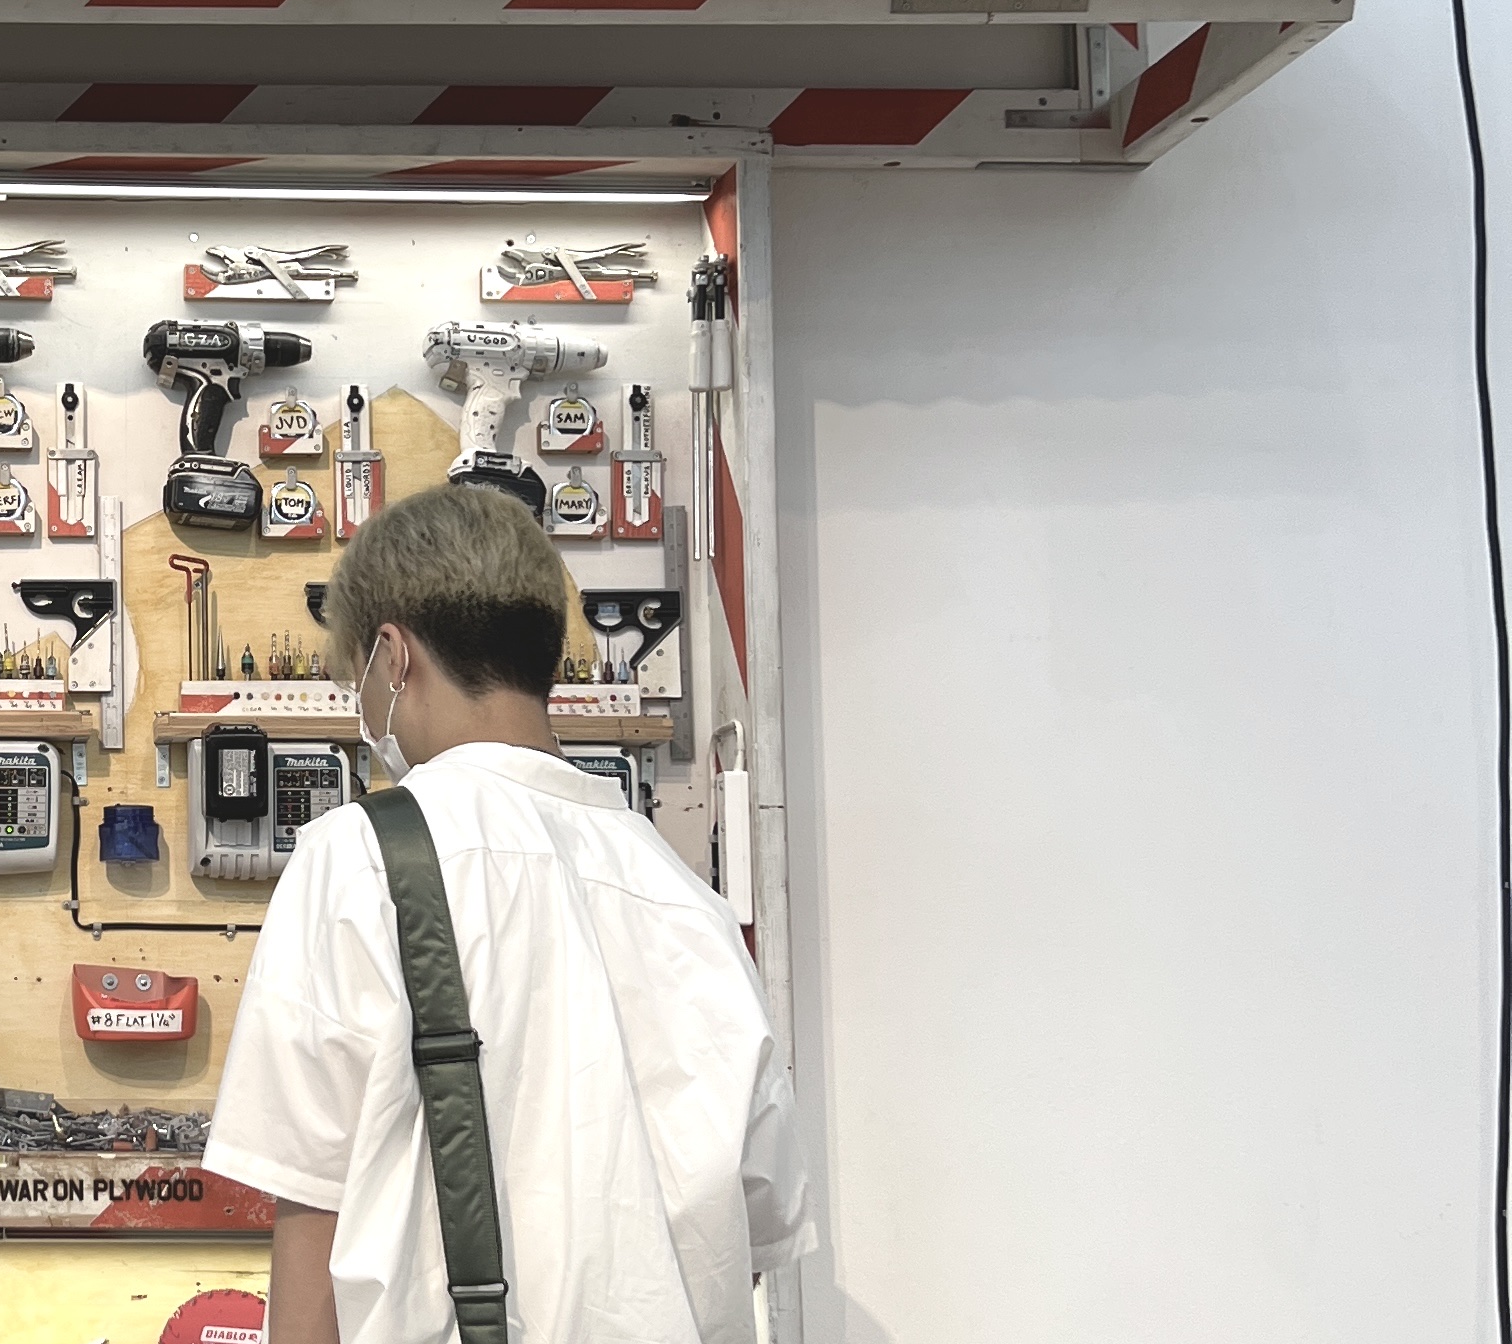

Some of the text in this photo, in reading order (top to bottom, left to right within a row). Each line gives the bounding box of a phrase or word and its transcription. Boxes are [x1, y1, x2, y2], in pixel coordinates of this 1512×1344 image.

[184, 333, 222, 347] GZA
[467, 333, 508, 346] U-GOD
[275, 415, 308, 431] JVD
[556, 413, 586, 424] SAM
[282, 497, 305, 508] TOM
[558, 497, 591, 509] MARY
[284, 757, 329, 767] makita
[573, 758, 617, 770] makita
[91, 1012, 114, 1028] #8
[115, 1014, 147, 1028] FLAT
[0, 1178, 49, 1202] WAR
[52, 1178, 84, 1202] ON
[93, 1178, 204, 1202] PLYWOOD
[205, 1329, 247, 1342] DIABLO
